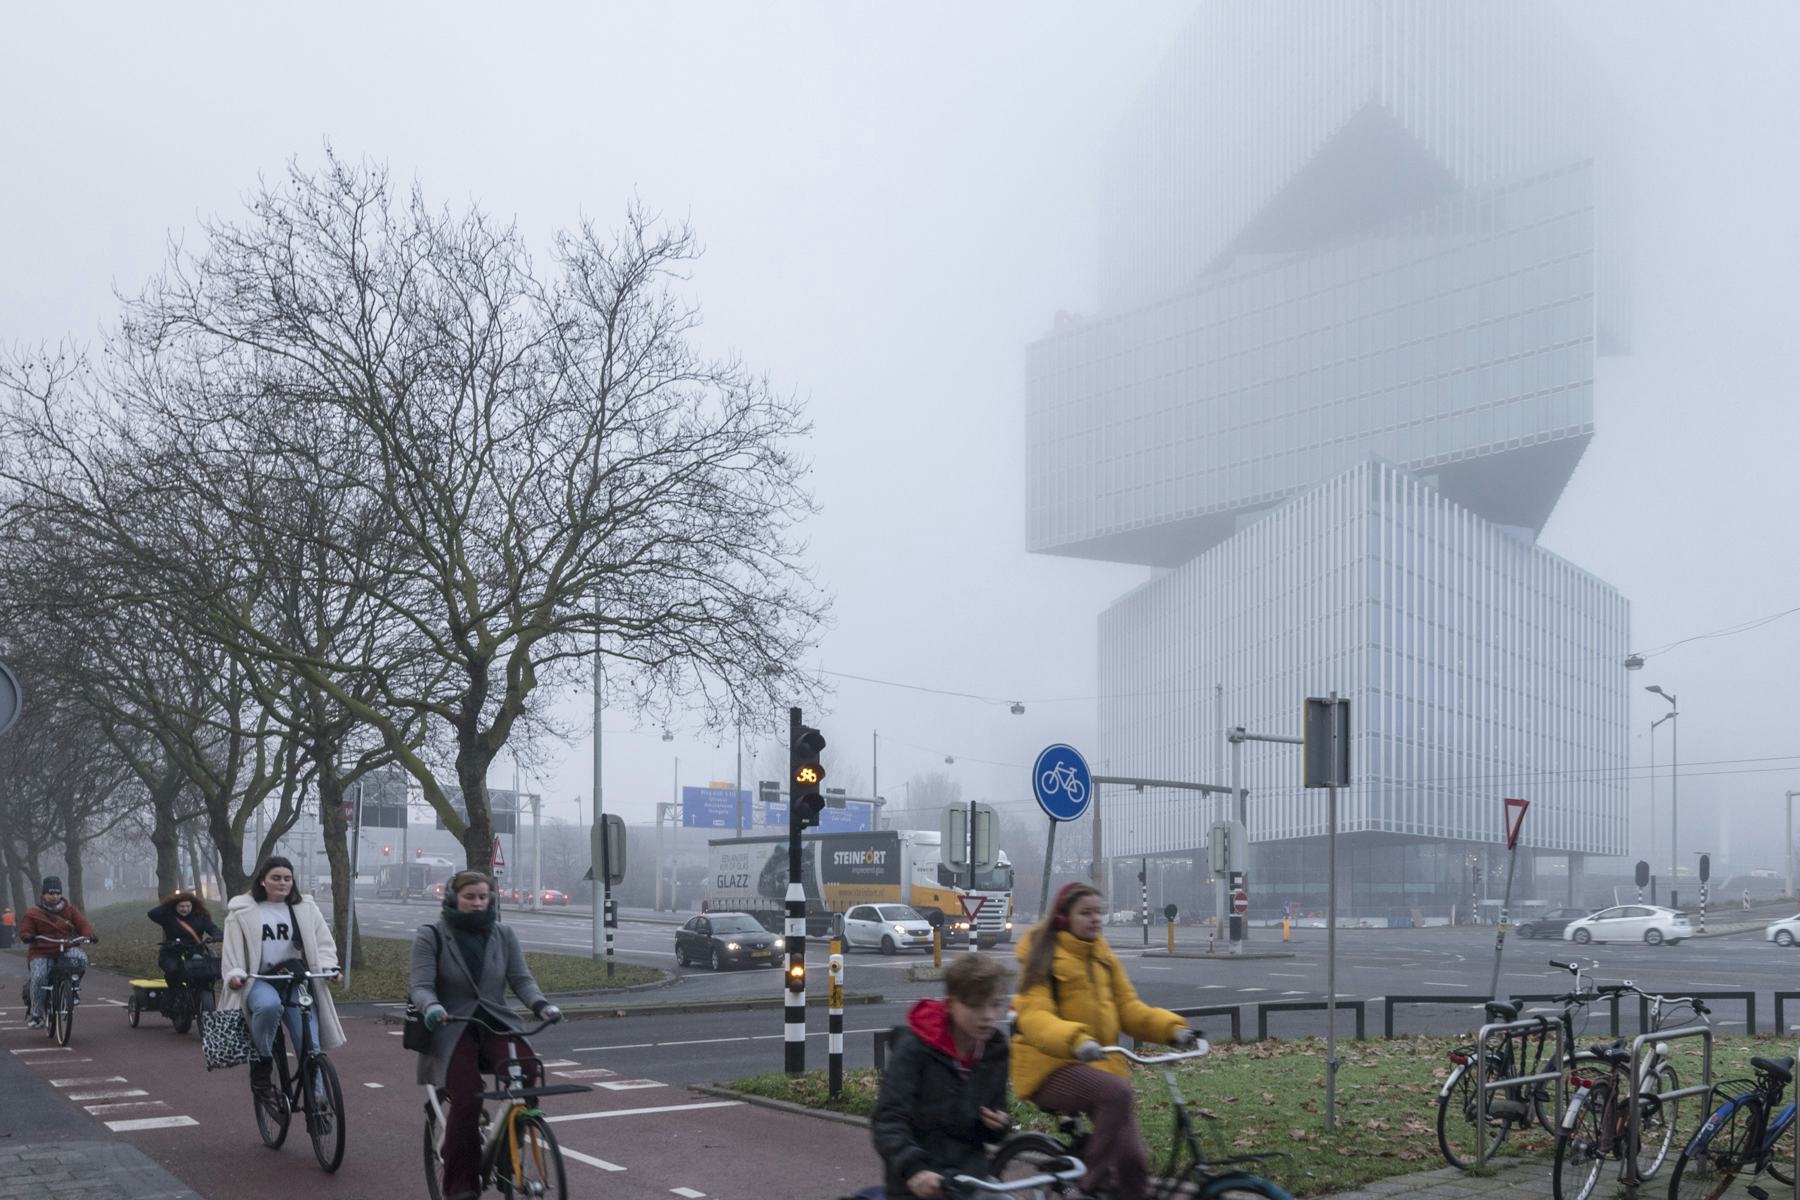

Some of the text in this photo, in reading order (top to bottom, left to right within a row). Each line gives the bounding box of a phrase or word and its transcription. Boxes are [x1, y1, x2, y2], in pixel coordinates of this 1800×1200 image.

[833, 849, 886, 865] STEINFORT
[717, 874, 749, 889] GLAZZ
[262, 923, 297, 941] AR
